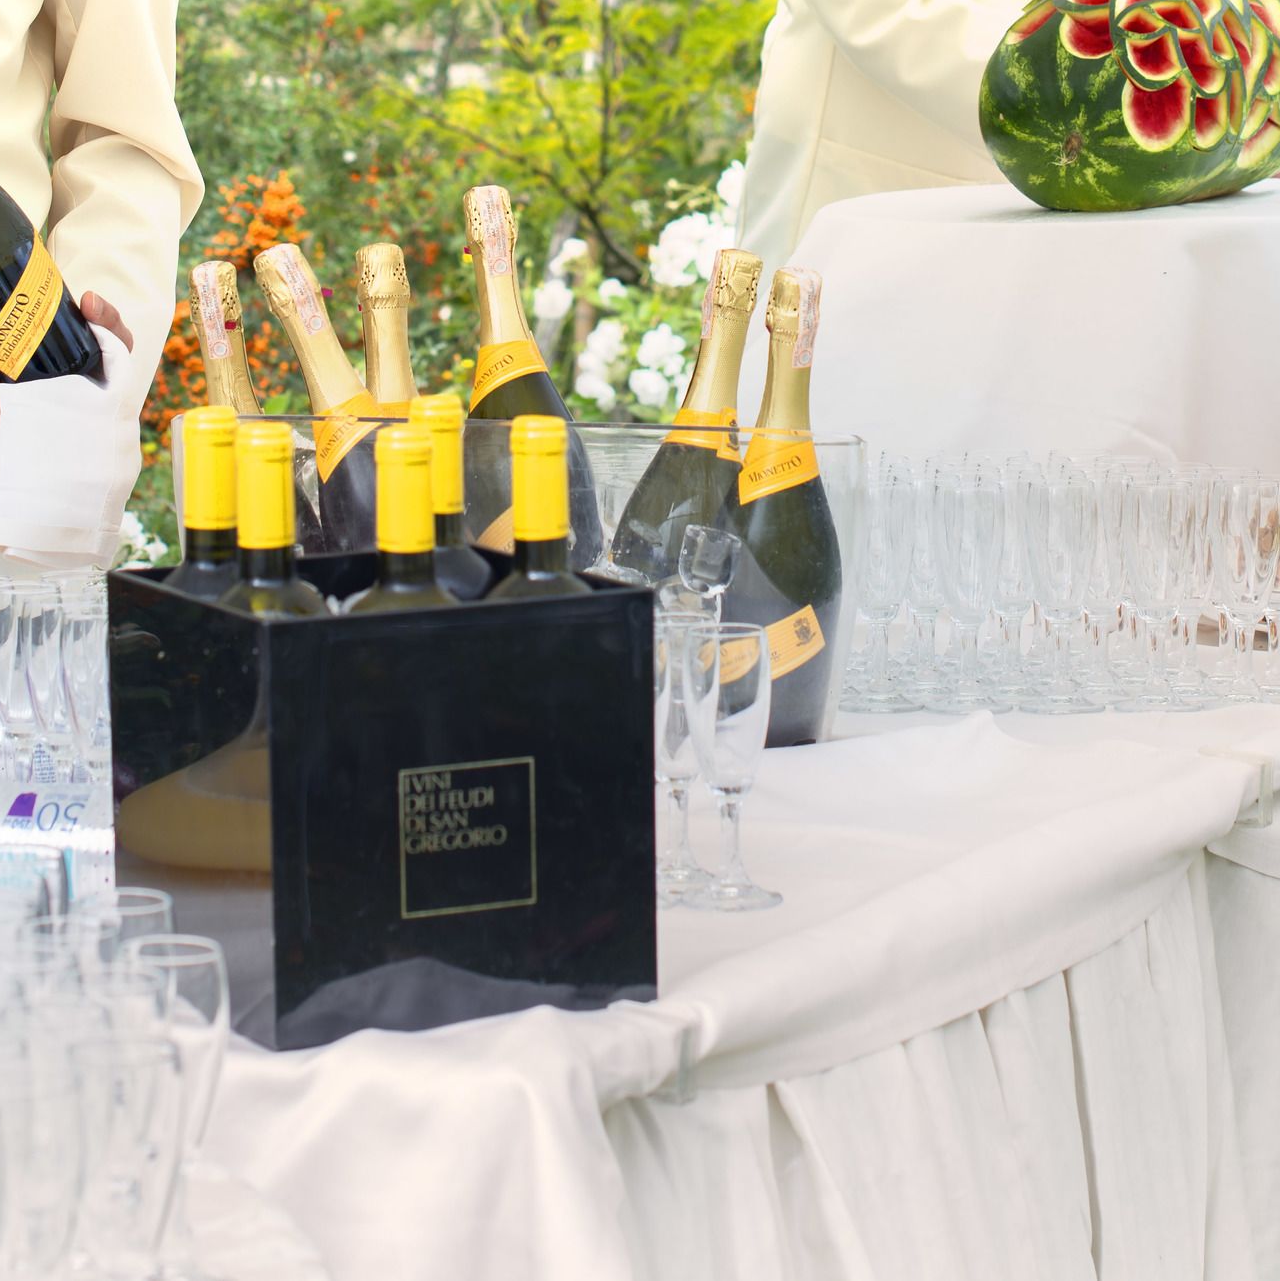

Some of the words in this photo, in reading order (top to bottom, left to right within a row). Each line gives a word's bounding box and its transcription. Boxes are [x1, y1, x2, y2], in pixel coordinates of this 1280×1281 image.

[749, 455, 802, 482] MIONETTO
[405, 793, 435, 814] DEI
[439, 785, 495, 811] FEUDI
[405, 815, 426, 834] DI
[430, 810, 469, 832] SAN
[405, 824, 508, 854] GREGORIO
